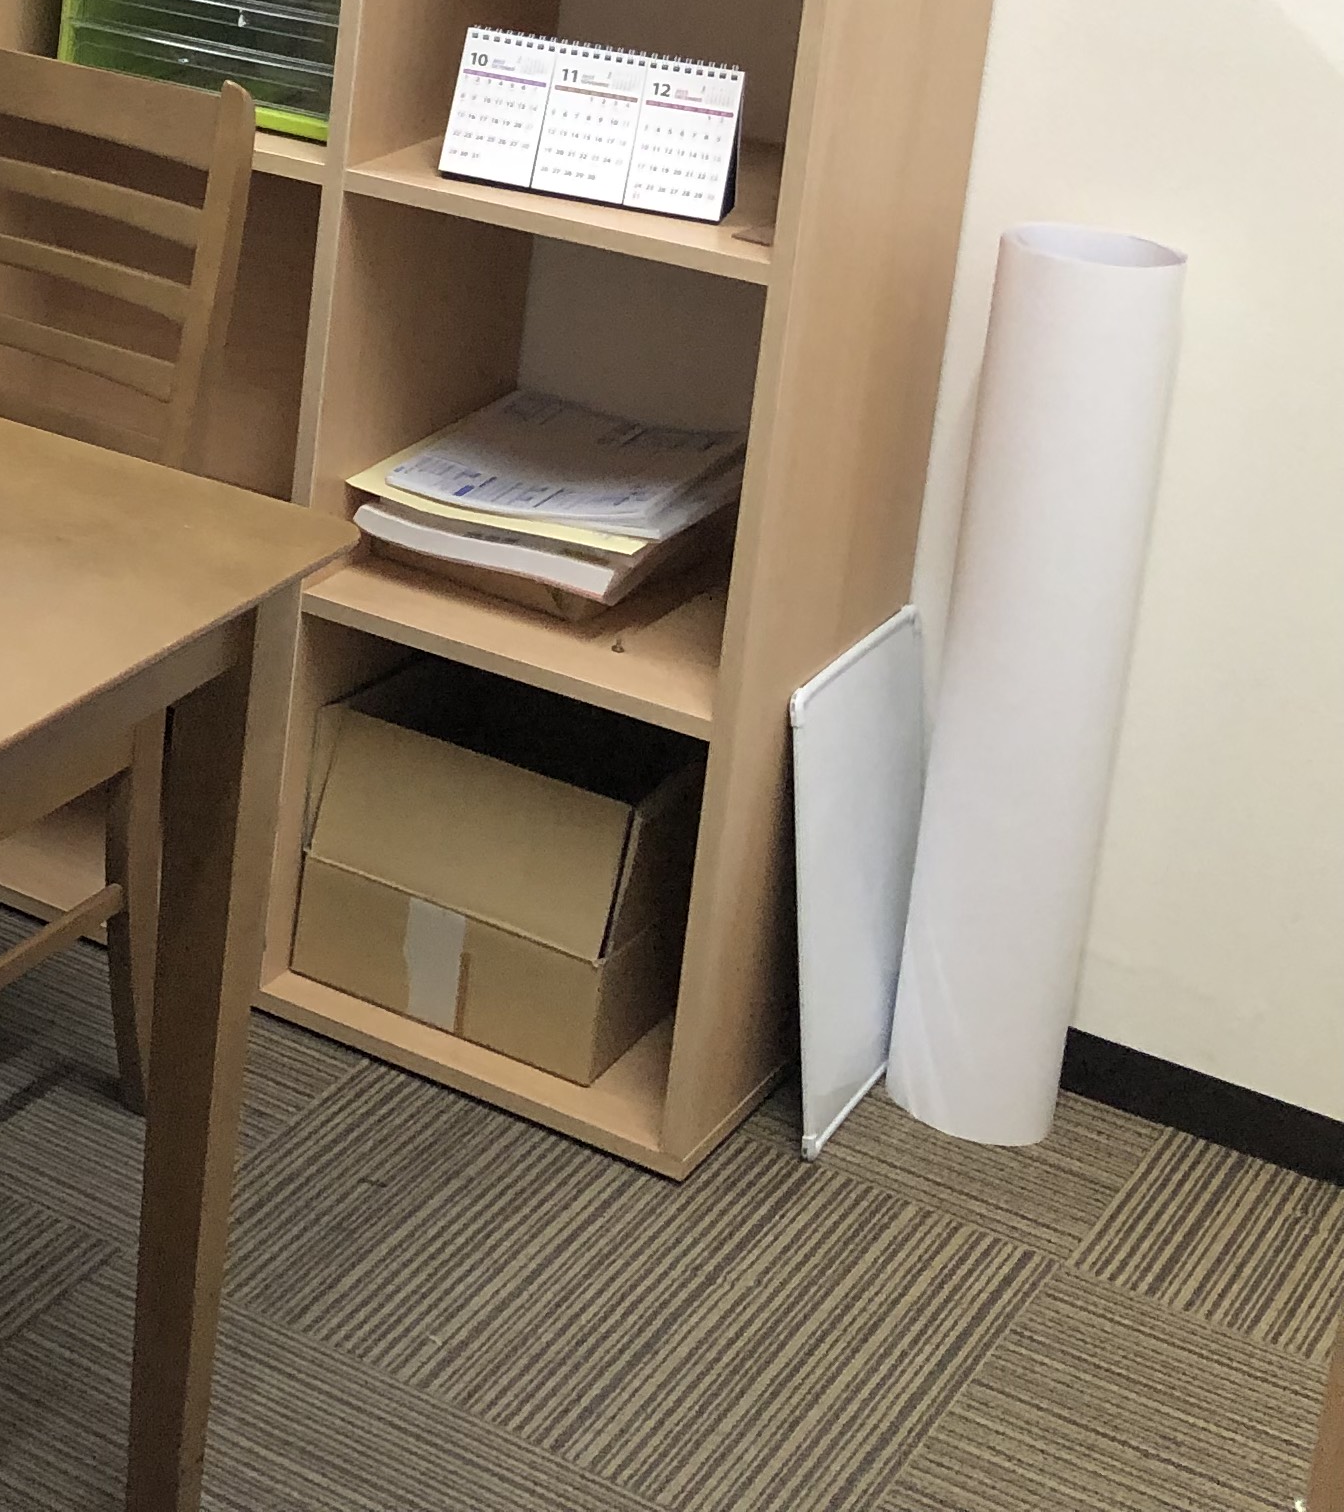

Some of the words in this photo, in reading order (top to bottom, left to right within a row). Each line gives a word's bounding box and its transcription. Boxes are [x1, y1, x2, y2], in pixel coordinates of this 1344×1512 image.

[470, 51, 489, 67] 10
[561, 68, 579, 83] 11
[653, 82, 671, 98] 12
